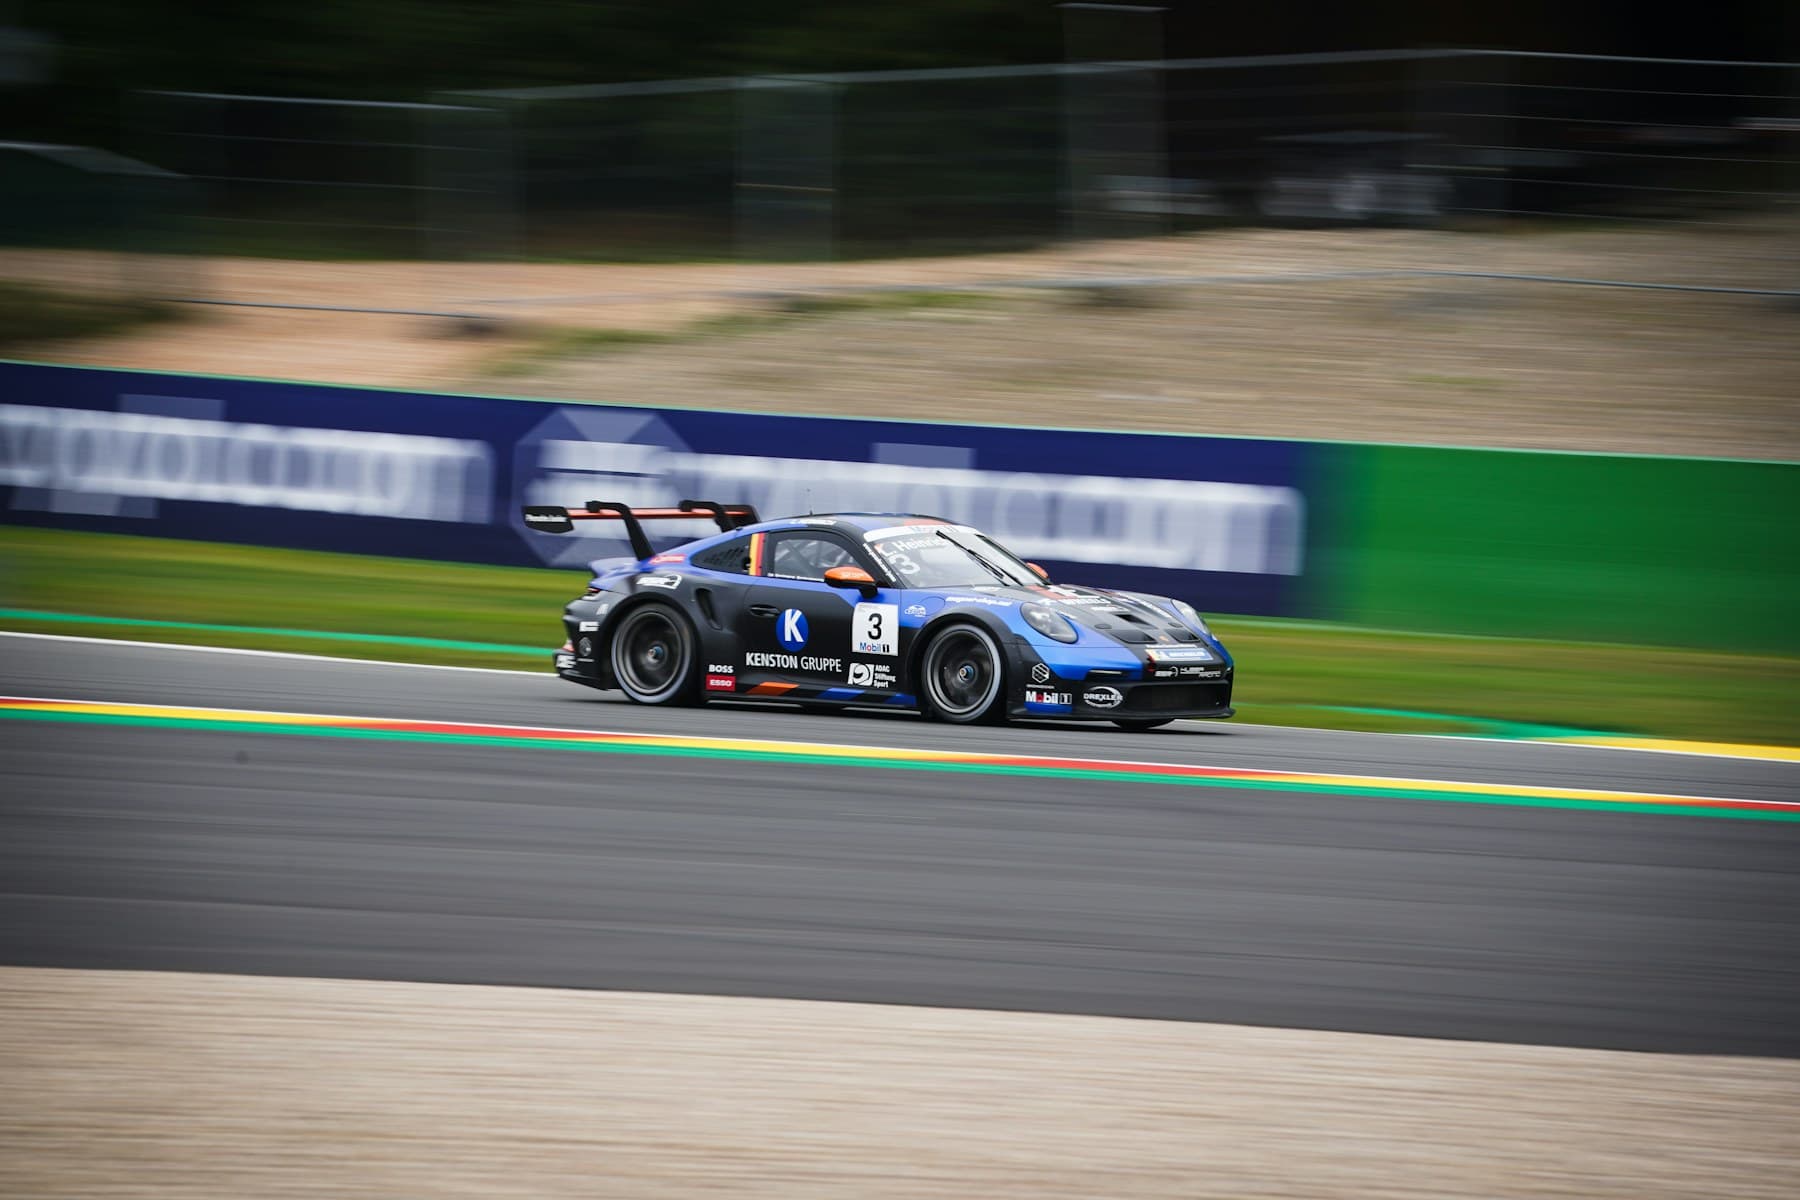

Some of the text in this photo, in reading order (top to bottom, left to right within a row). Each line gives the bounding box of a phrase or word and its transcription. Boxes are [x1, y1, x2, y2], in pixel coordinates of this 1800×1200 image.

[887, 554, 920, 575] 3
[785, 608, 804, 642] K
[867, 613, 882, 640] 3
[860, 642, 881, 652] Mobil
[746, 652, 842, 672] KENSTON GRUPPE
[709, 664, 734, 674] BOSS
[875, 664, 890, 673] ADAC
[873, 680, 889, 688] Sport
[1025, 691, 1058, 704] Mobil
[1083, 692, 1123, 702] DREXLER
